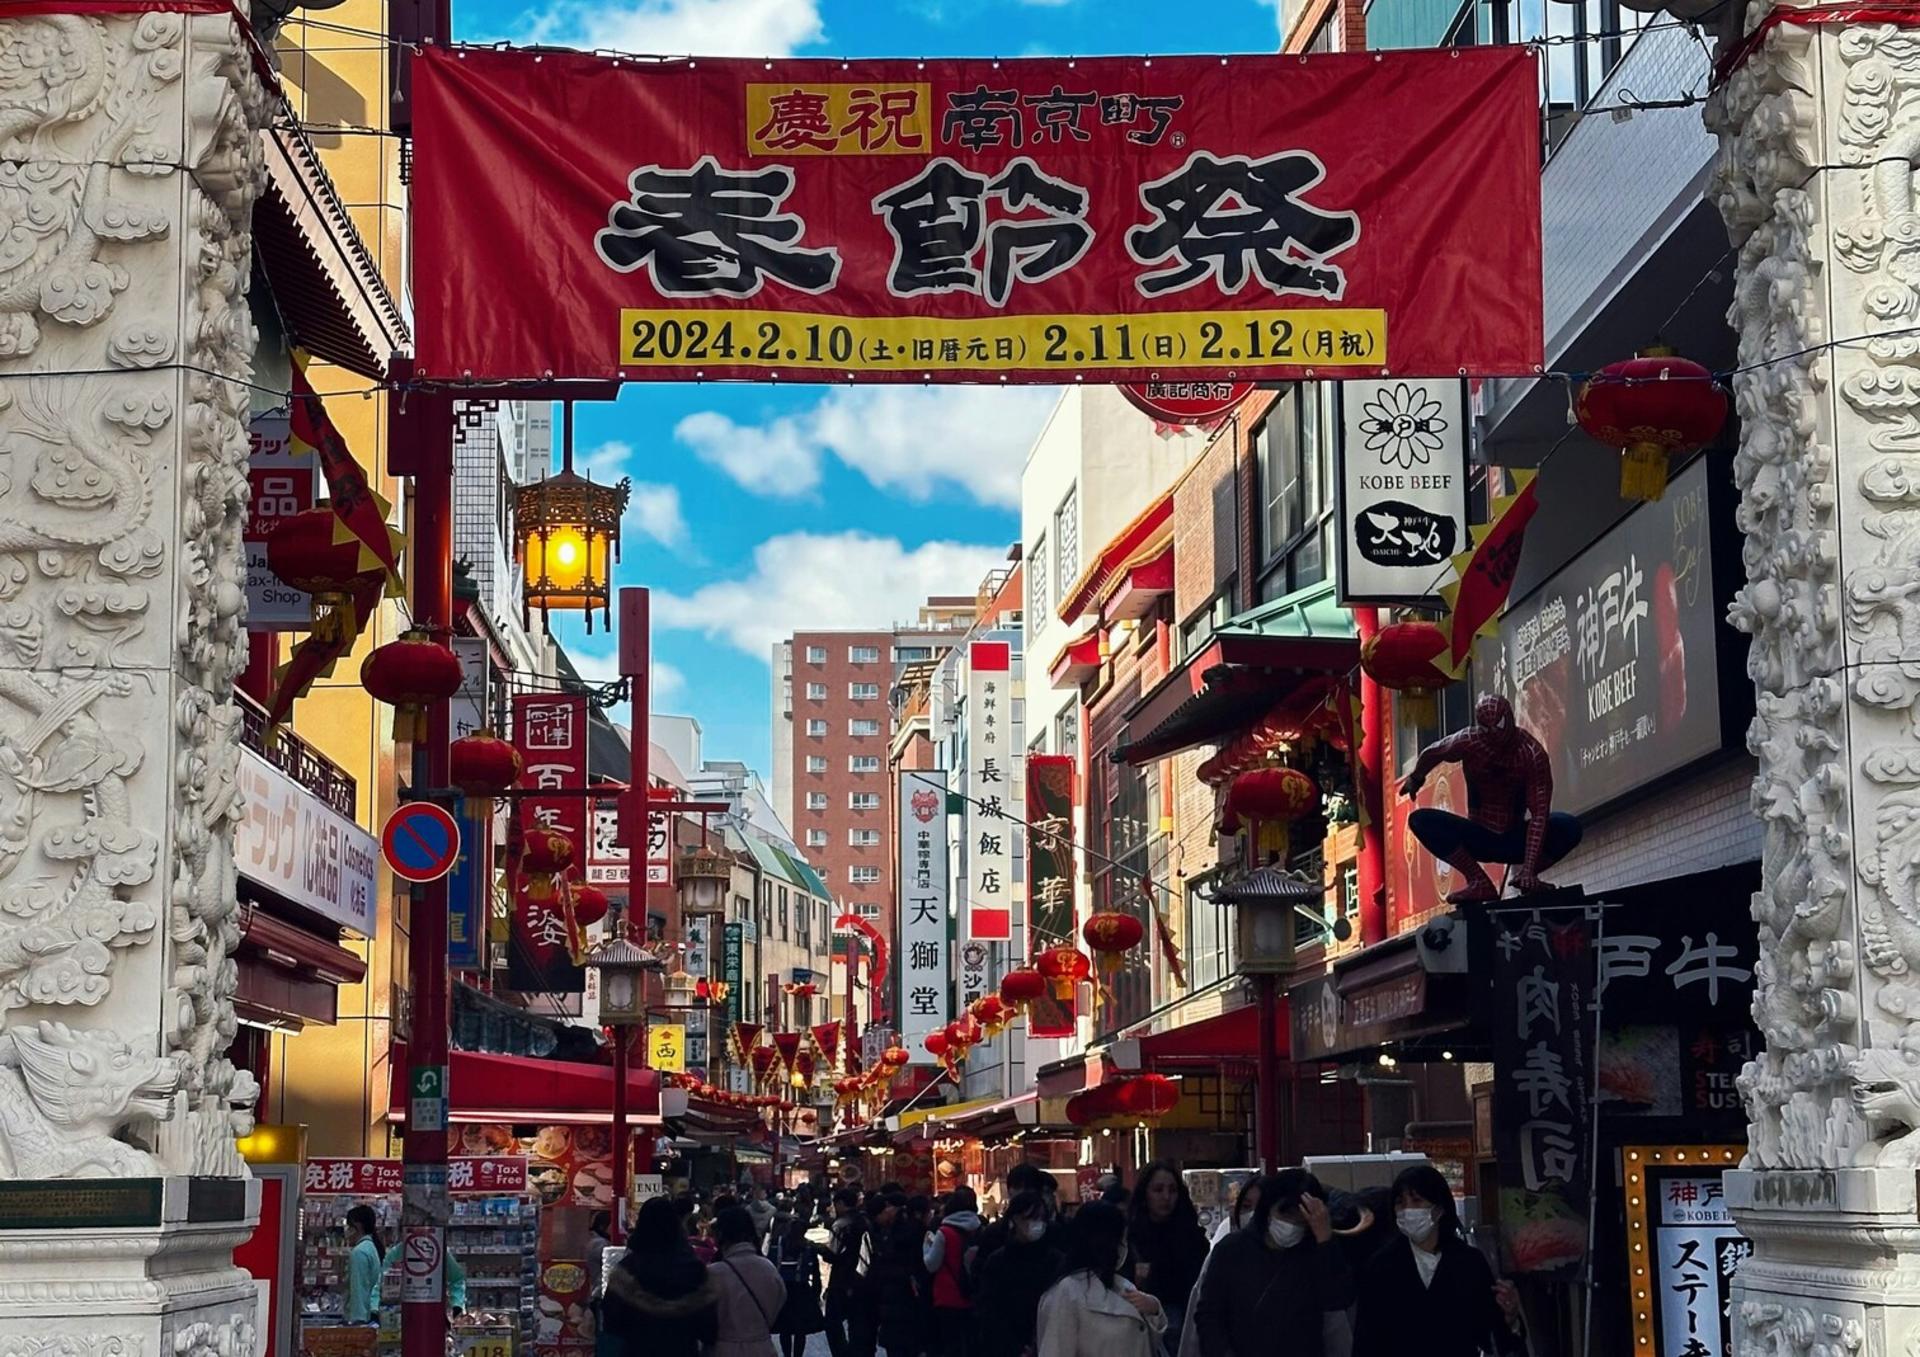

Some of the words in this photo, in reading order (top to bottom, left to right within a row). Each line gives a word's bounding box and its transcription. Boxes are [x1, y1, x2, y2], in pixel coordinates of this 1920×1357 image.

[755, 88, 924, 152] 慶祝
[594, 149, 1361, 308] 春節祭
[1360, 475, 1404, 489] KOBE
[1411, 475, 1452, 489] BEEF
[262, 588, 301, 605] Shop
[1576, 554, 1648, 681] 神戸牛
[1588, 669, 1614, 722] KOBE
[1614, 659, 1638, 707] BEEF
[978, 757, 1004, 894] 長城飯店
[303, 808, 339, 904] 化粧品
[344, 834, 374, 881] Cosmetics
[909, 897, 940, 1016] 天獅堂
[305, 1162, 354, 1190] 免税
[377, 1166, 399, 1176] Tax
[377, 1178, 402, 1187] Free
[496, 1175, 522, 1184] Free
[497, 1164, 519, 1174] Tax
[634, 1183, 660, 1193] ENU
[1687, 1211, 1720, 1221] KOBE
